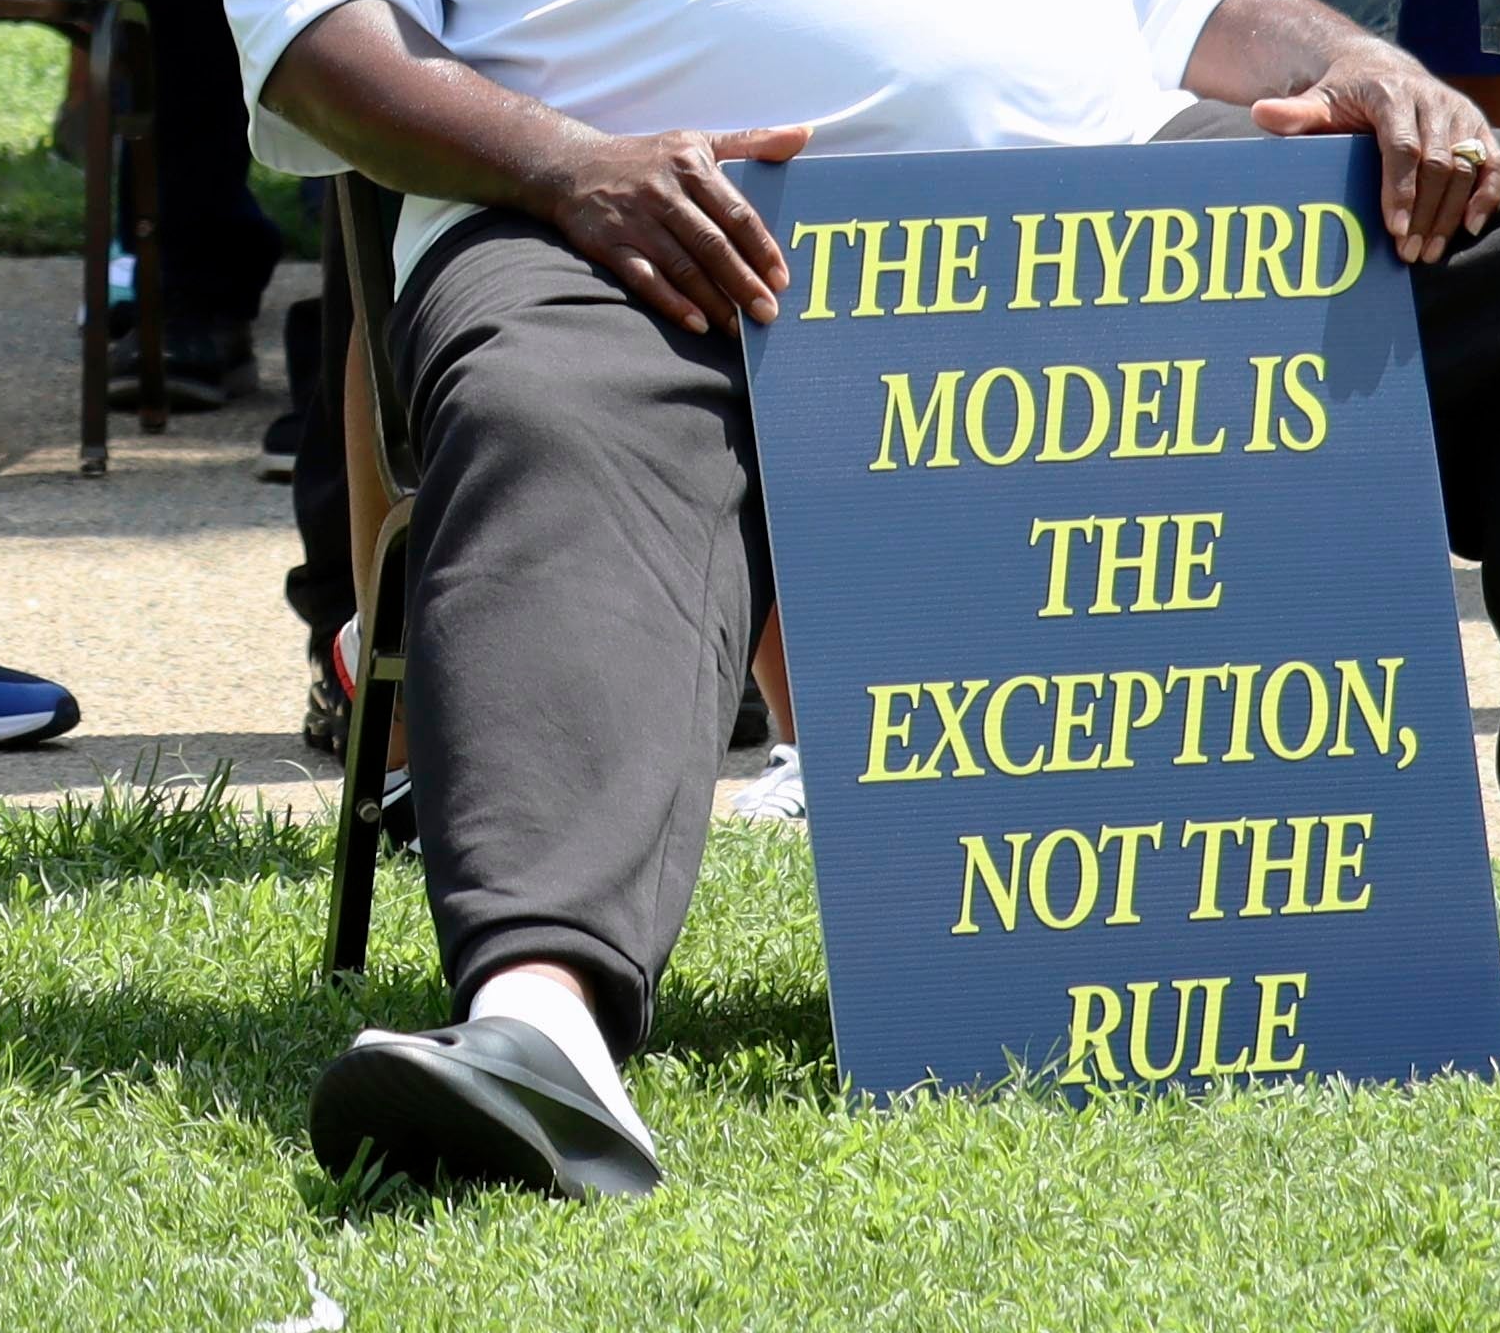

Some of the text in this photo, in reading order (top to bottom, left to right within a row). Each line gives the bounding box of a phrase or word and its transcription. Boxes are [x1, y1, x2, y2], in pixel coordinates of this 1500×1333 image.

[790, 201, 1367, 321] THE HYBIRD
[869, 352, 1329, 472] MODEL IS
[1028, 511, 1225, 620] THE
[858, 655, 1419, 785] EXCEPTION,
[951, 812, 1375, 937] NOT THE
[1060, 971, 1309, 1087] RULE
